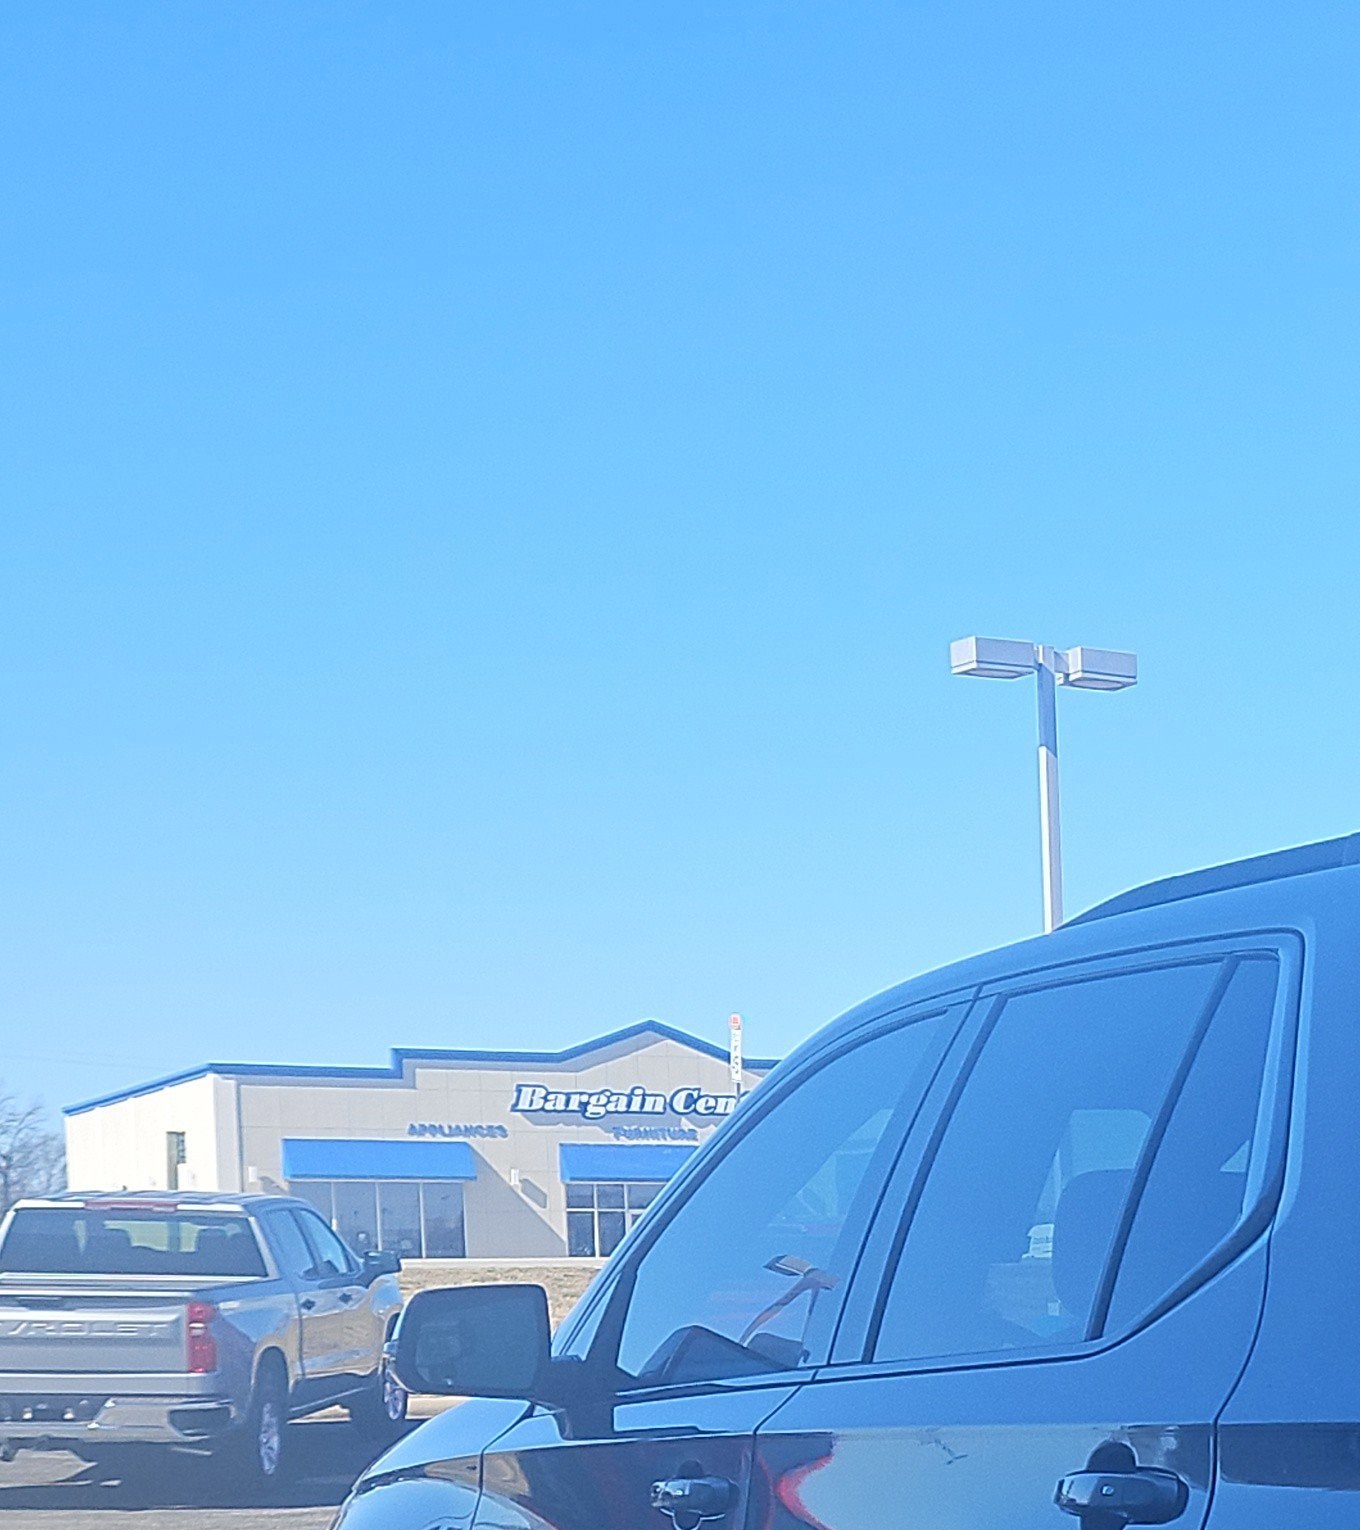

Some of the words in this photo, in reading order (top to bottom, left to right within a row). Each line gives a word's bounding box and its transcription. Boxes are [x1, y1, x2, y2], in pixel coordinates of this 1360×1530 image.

[510, 1083, 669, 1118] Bargain
[669, 1086, 750, 1116] Cen
[407, 1123, 508, 1138] APPLIANCES
